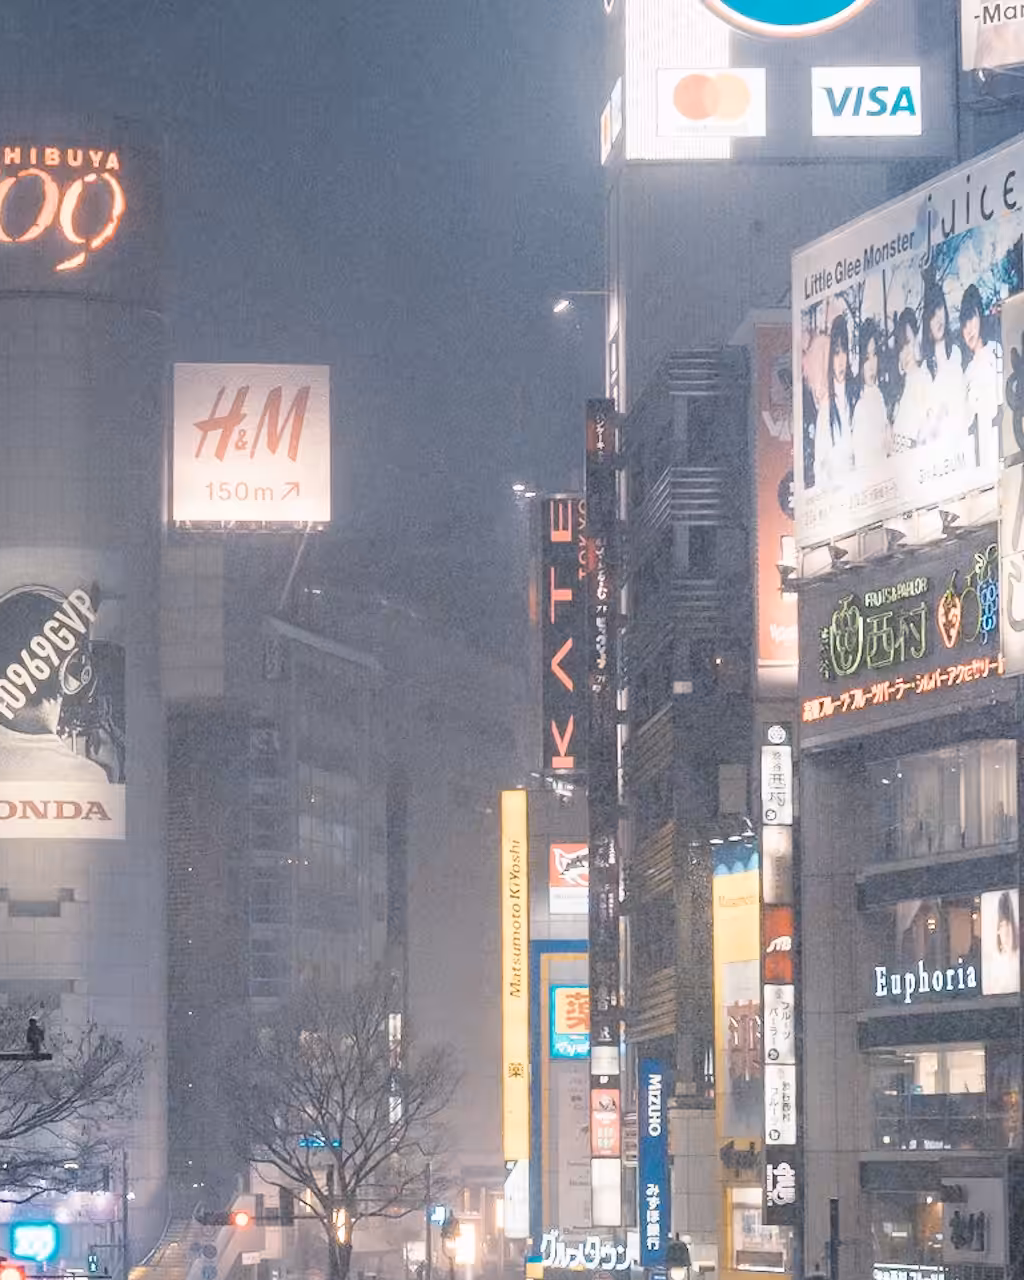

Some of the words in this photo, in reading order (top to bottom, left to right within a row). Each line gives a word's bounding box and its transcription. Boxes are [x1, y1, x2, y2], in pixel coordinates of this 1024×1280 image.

[819, 85, 916, 117] VISA
[804, 270, 833, 300] Little
[834, 256, 862, 286] Glee
[863, 231, 915, 272] Monster
[193, 385, 311, 462] H&M
[867, 602, 928, 670] 西村
[510, 905, 522, 998] Matsumoto
[875, 957, 977, 1003] Euphoria
[648, 1074, 662, 1137] MIZUHO
